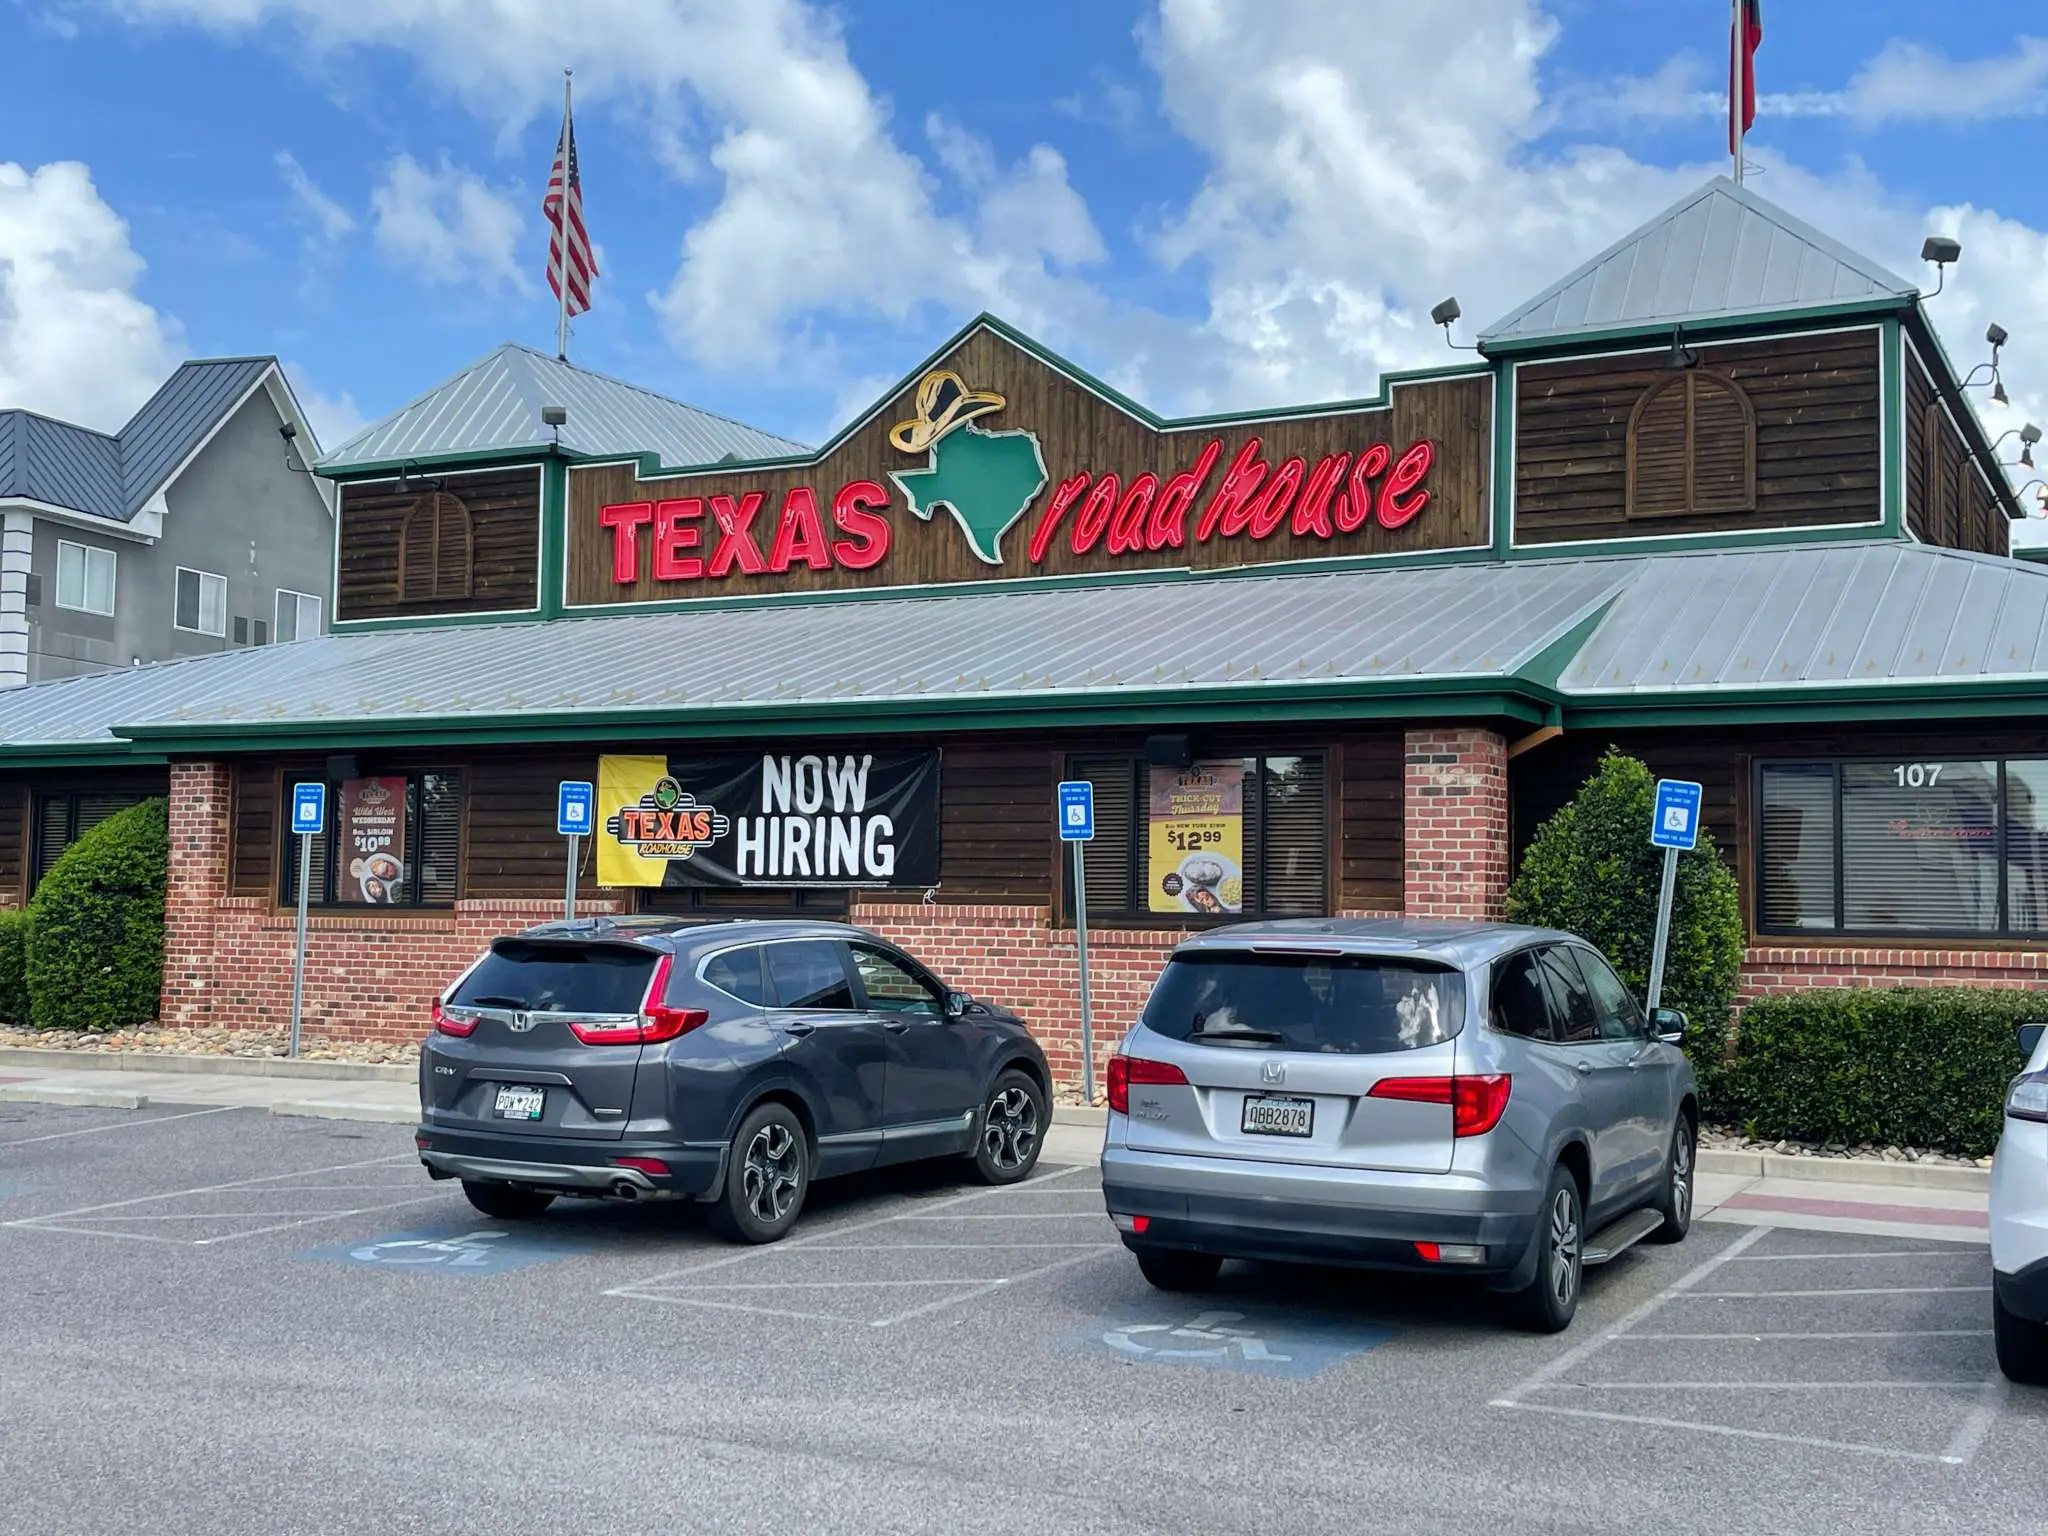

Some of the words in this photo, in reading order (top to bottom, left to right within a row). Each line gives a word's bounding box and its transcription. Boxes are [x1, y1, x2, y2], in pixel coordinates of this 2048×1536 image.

[601, 480, 892, 583] TEXAS
[762, 754, 873, 813] NOW
[1894, 764, 1943, 787] 107
[352, 816, 396, 824] WEDNESDAY
[353, 806, 373, 816] Wild
[367, 828, 394, 836] SIRLOIN
[624, 812, 710, 840] TEXAS
[640, 843, 692, 855] ROADHOUSE
[737, 815, 895, 876] HIRING
